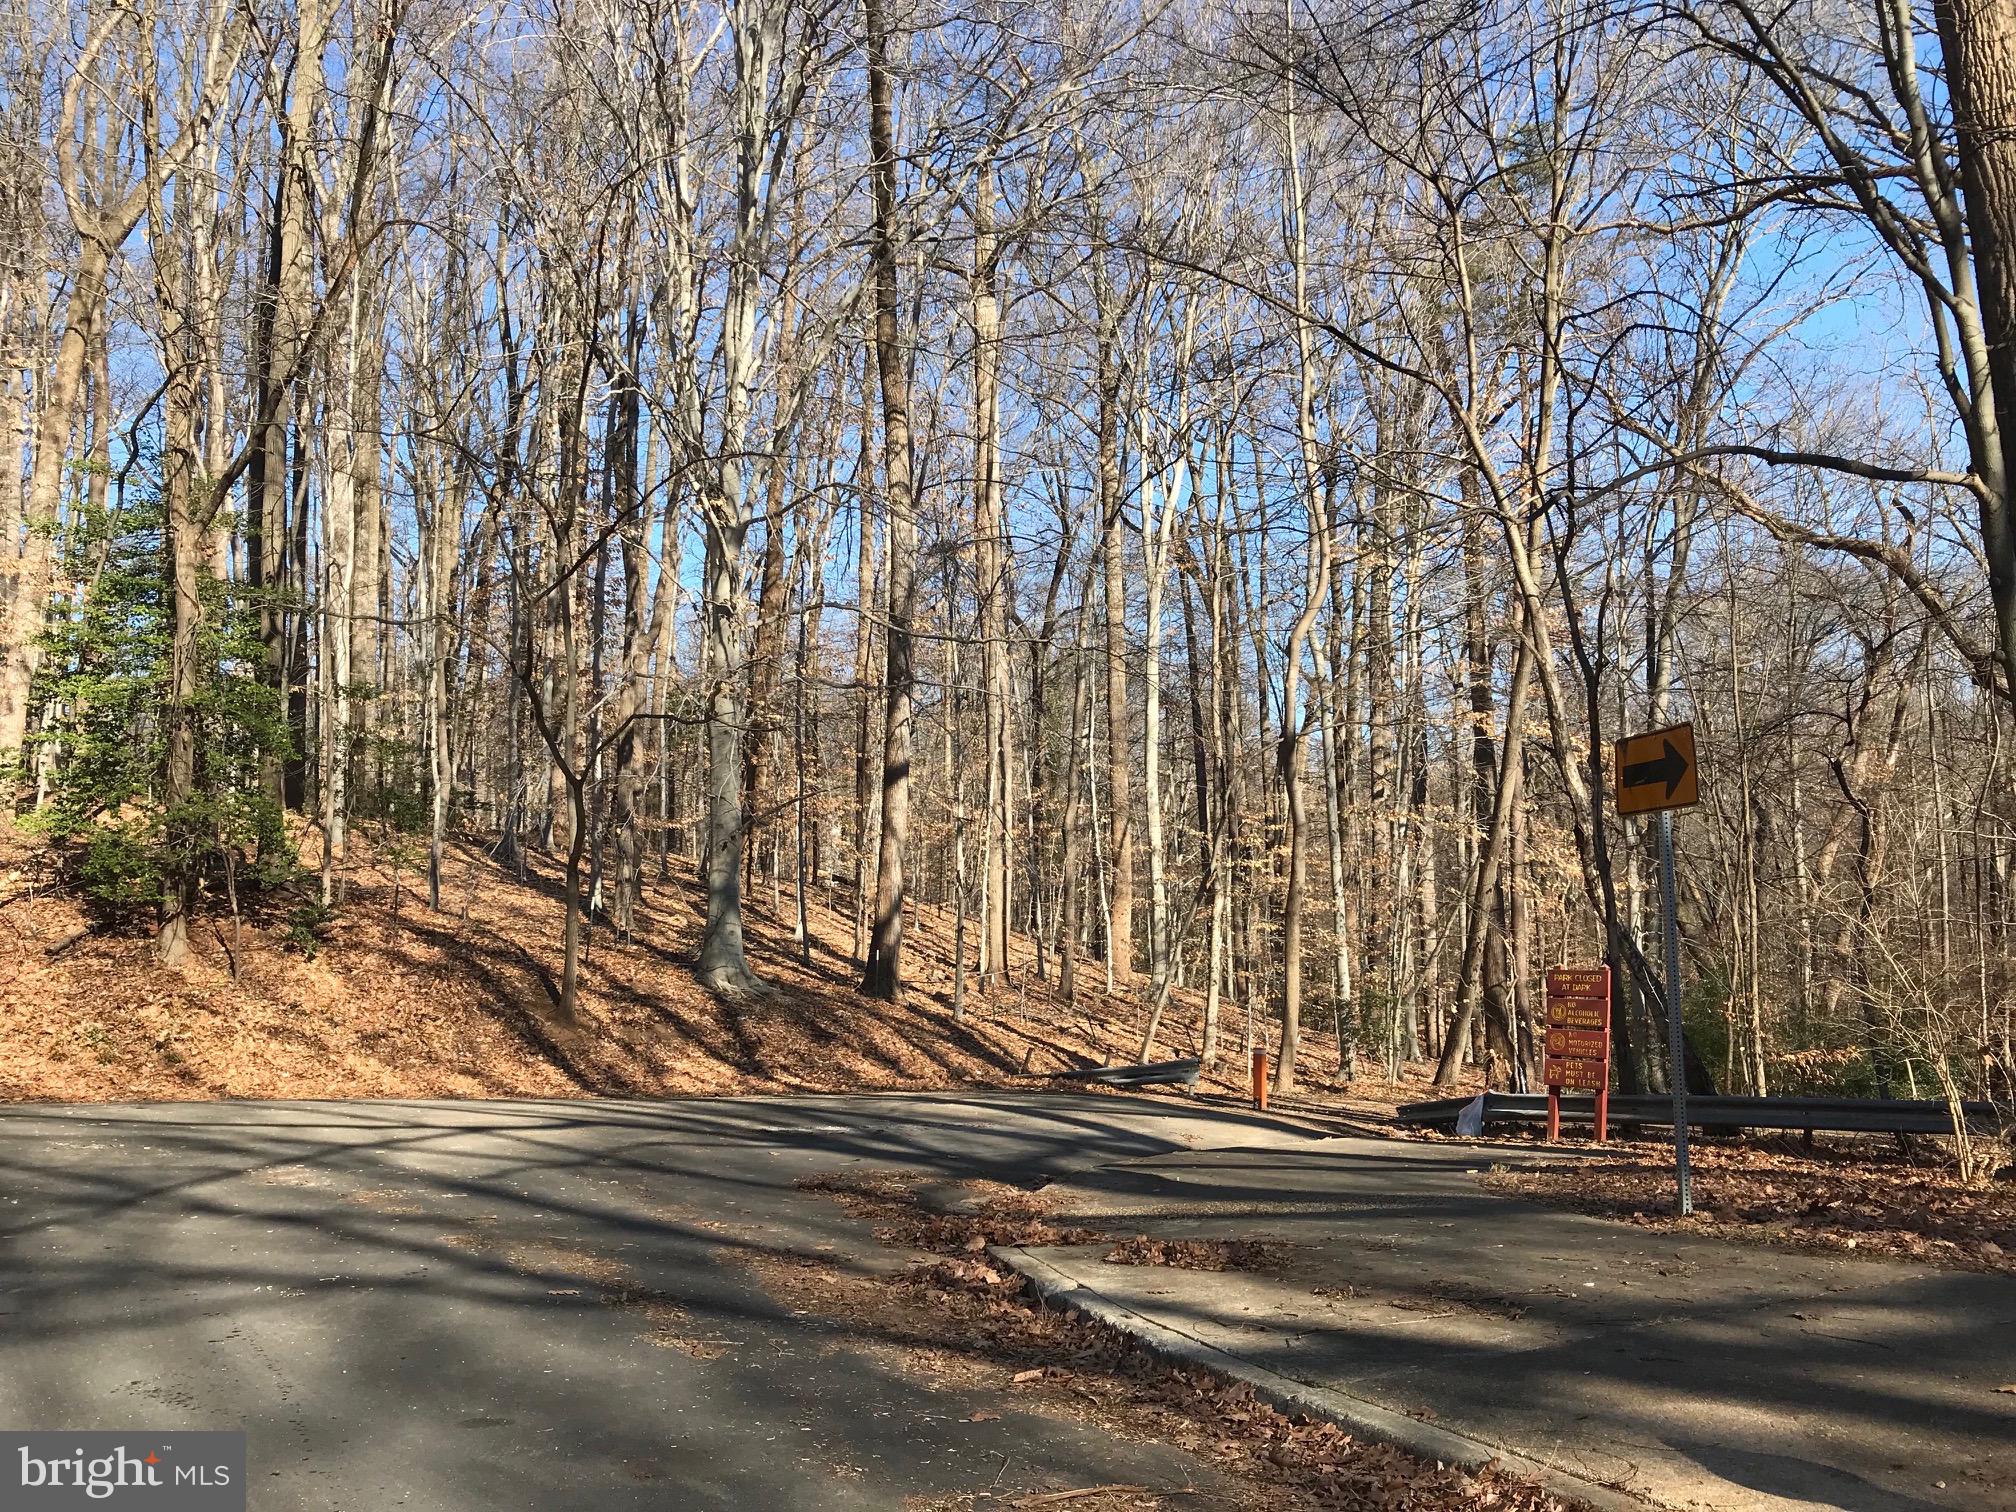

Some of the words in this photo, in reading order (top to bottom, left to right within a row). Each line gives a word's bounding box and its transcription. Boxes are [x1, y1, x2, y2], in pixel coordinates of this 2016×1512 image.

[1574, 974, 1602, 983] CLOSED
[1561, 983, 1570, 991] AT
[1567, 1009, 1600, 1018] ALCOHOLIC
[1566, 1017, 1602, 1026] BEVERAGES
[1568, 1039, 1603, 1049] MOTORIZED
[1568, 1047, 1598, 1056] VEHICLES
[1565, 1061, 1583, 1070] PETS
[1565, 1070, 1583, 1078] MUST
[1587, 1071, 1595, 1079] BE
[1578, 1079, 1601, 1088] LEASH
